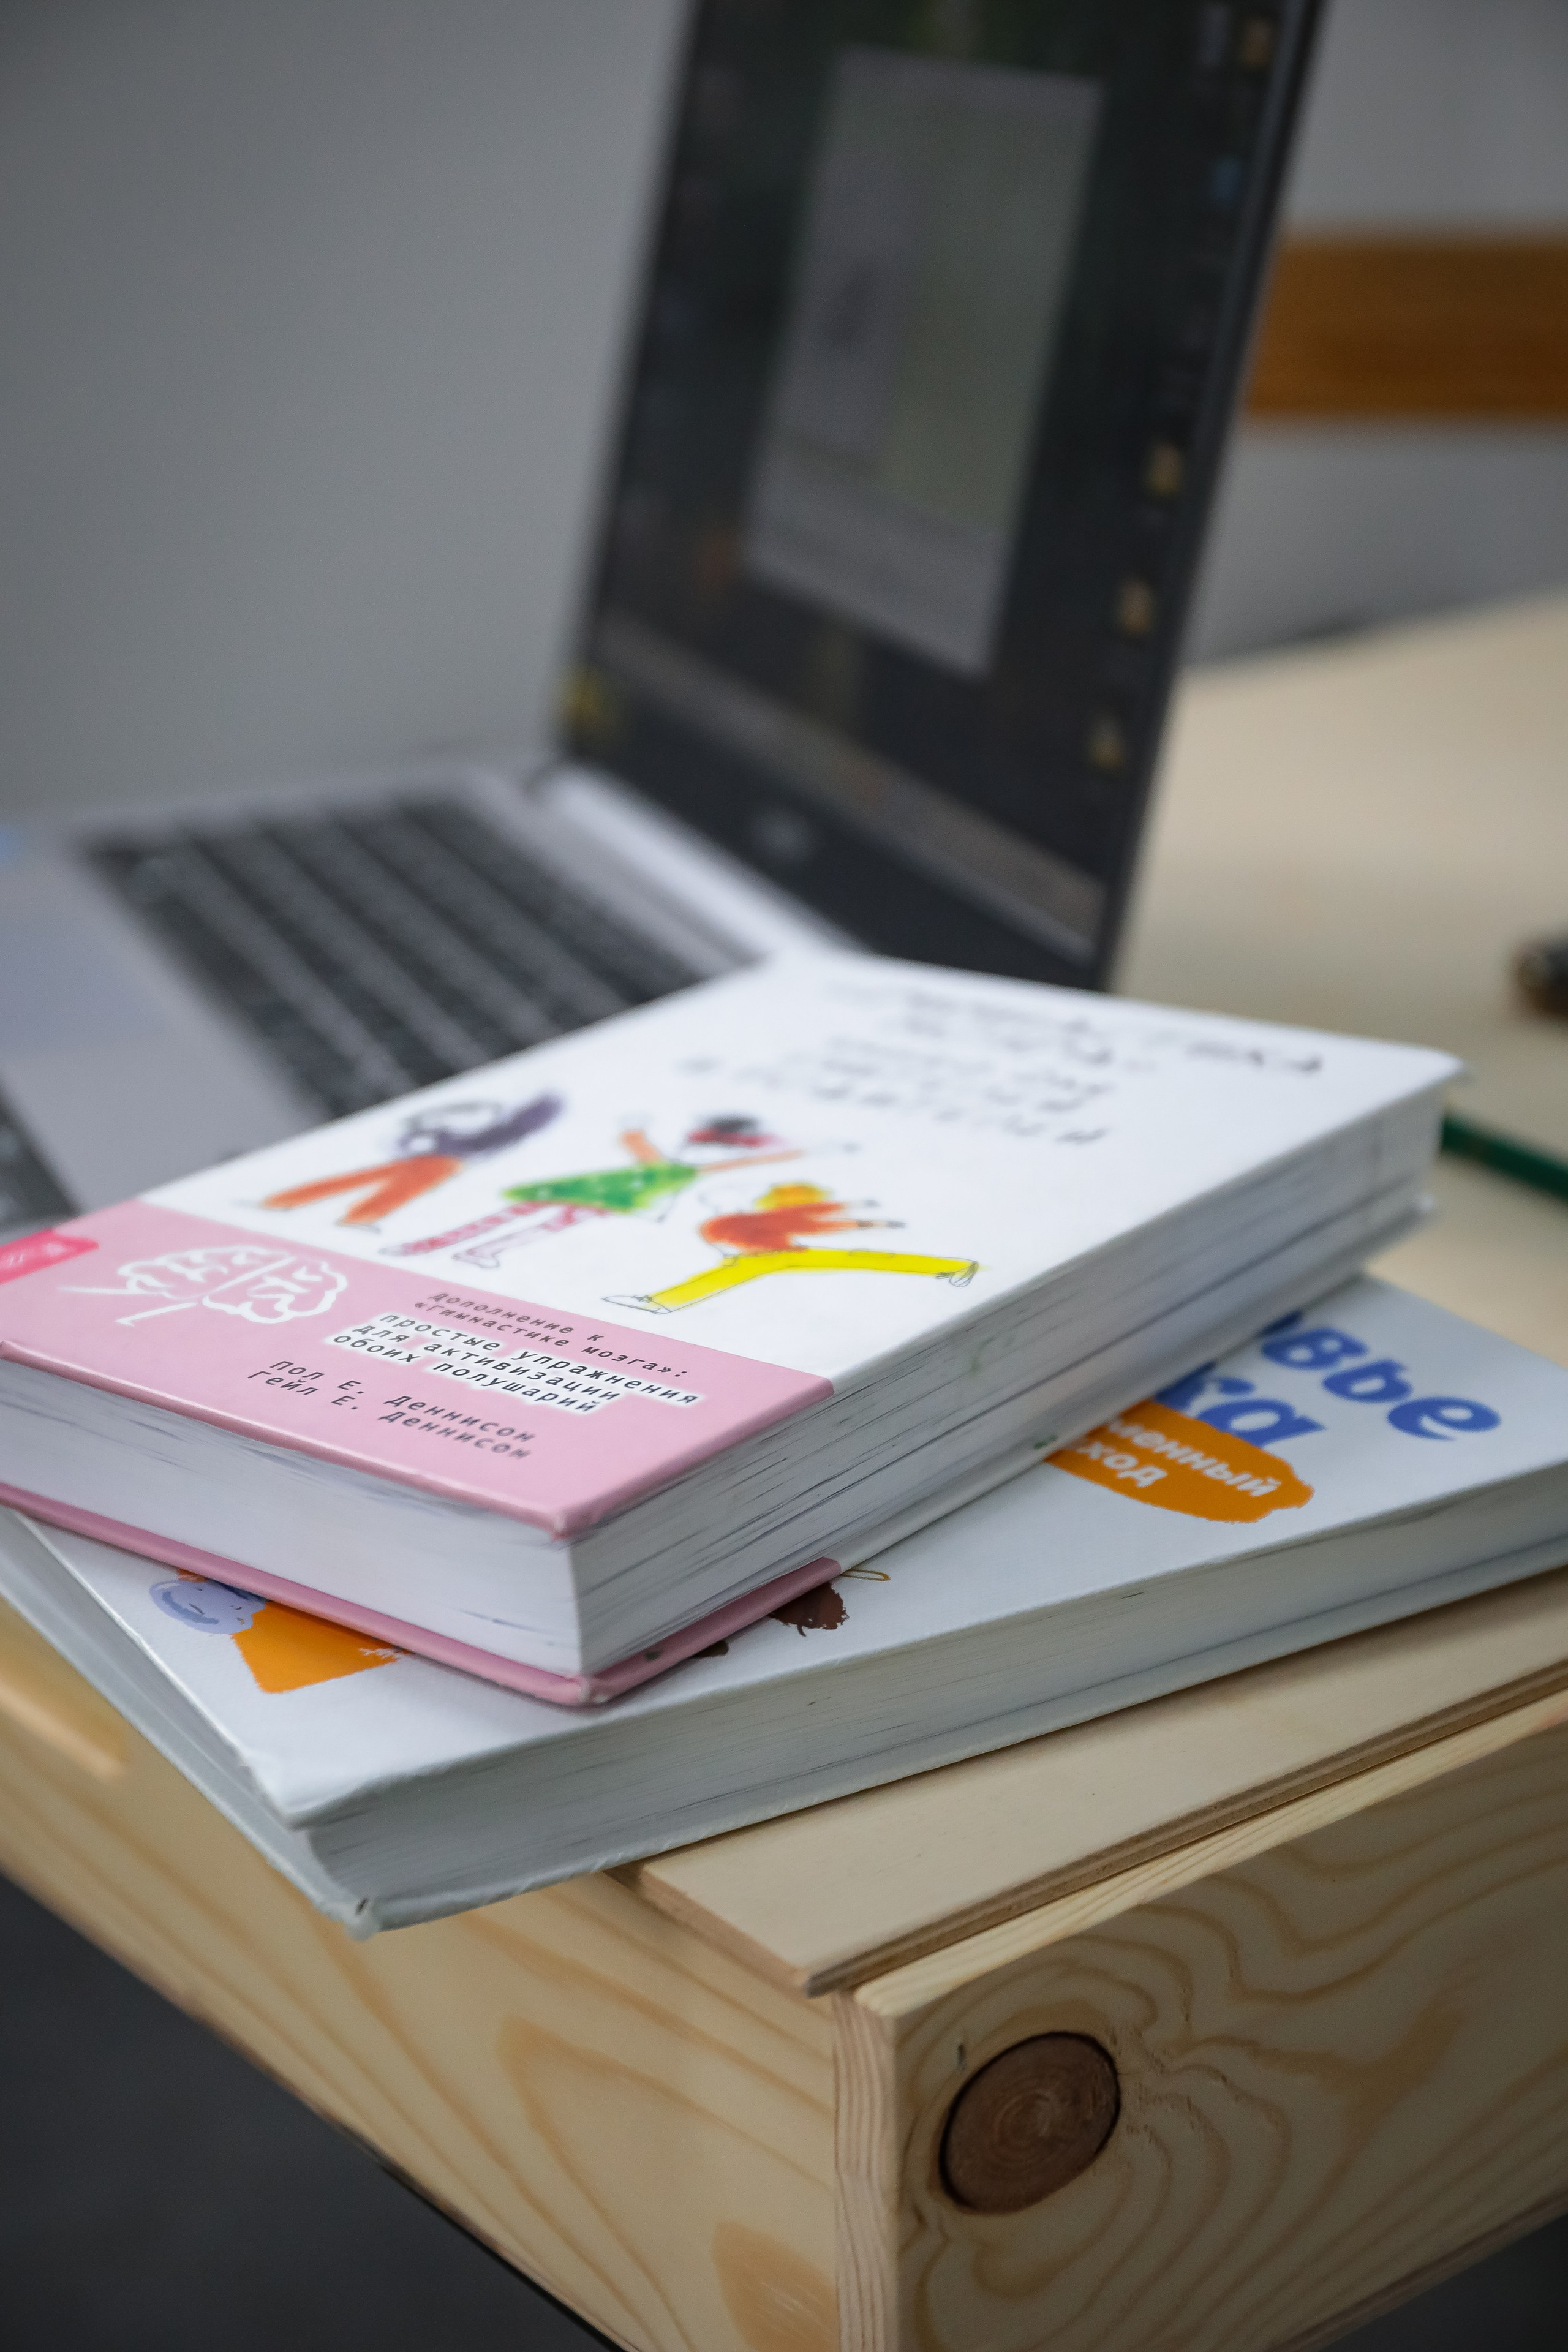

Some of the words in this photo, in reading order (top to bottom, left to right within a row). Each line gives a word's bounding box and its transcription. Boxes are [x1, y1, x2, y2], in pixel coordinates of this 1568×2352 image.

[415, 1302, 569, 1346] «Гимнастике
[582, 1347, 687, 1377] мозга»:
[428, 1293, 574, 1334] Дополнение
[333, 1335, 420, 1363] обоих
[432, 1363, 601, 1412] полушарий
[352, 1325, 410, 1343] для
[423, 1343, 620, 1400] активизации
[380, 1315, 500, 1351] простые
[510, 1351, 699, 1404] упражнения
[1259, 1311, 1501, 1440] вье
[247, 1371, 319, 1395] Гейл
[377, 1411, 532, 1459] Деннисон
[270, 1360, 325, 1380] Пол
[383, 1395, 536, 1442] Деннисон
[1076, 1441, 1168, 1488] ход
[1107, 1420, 1281, 1496] менный
